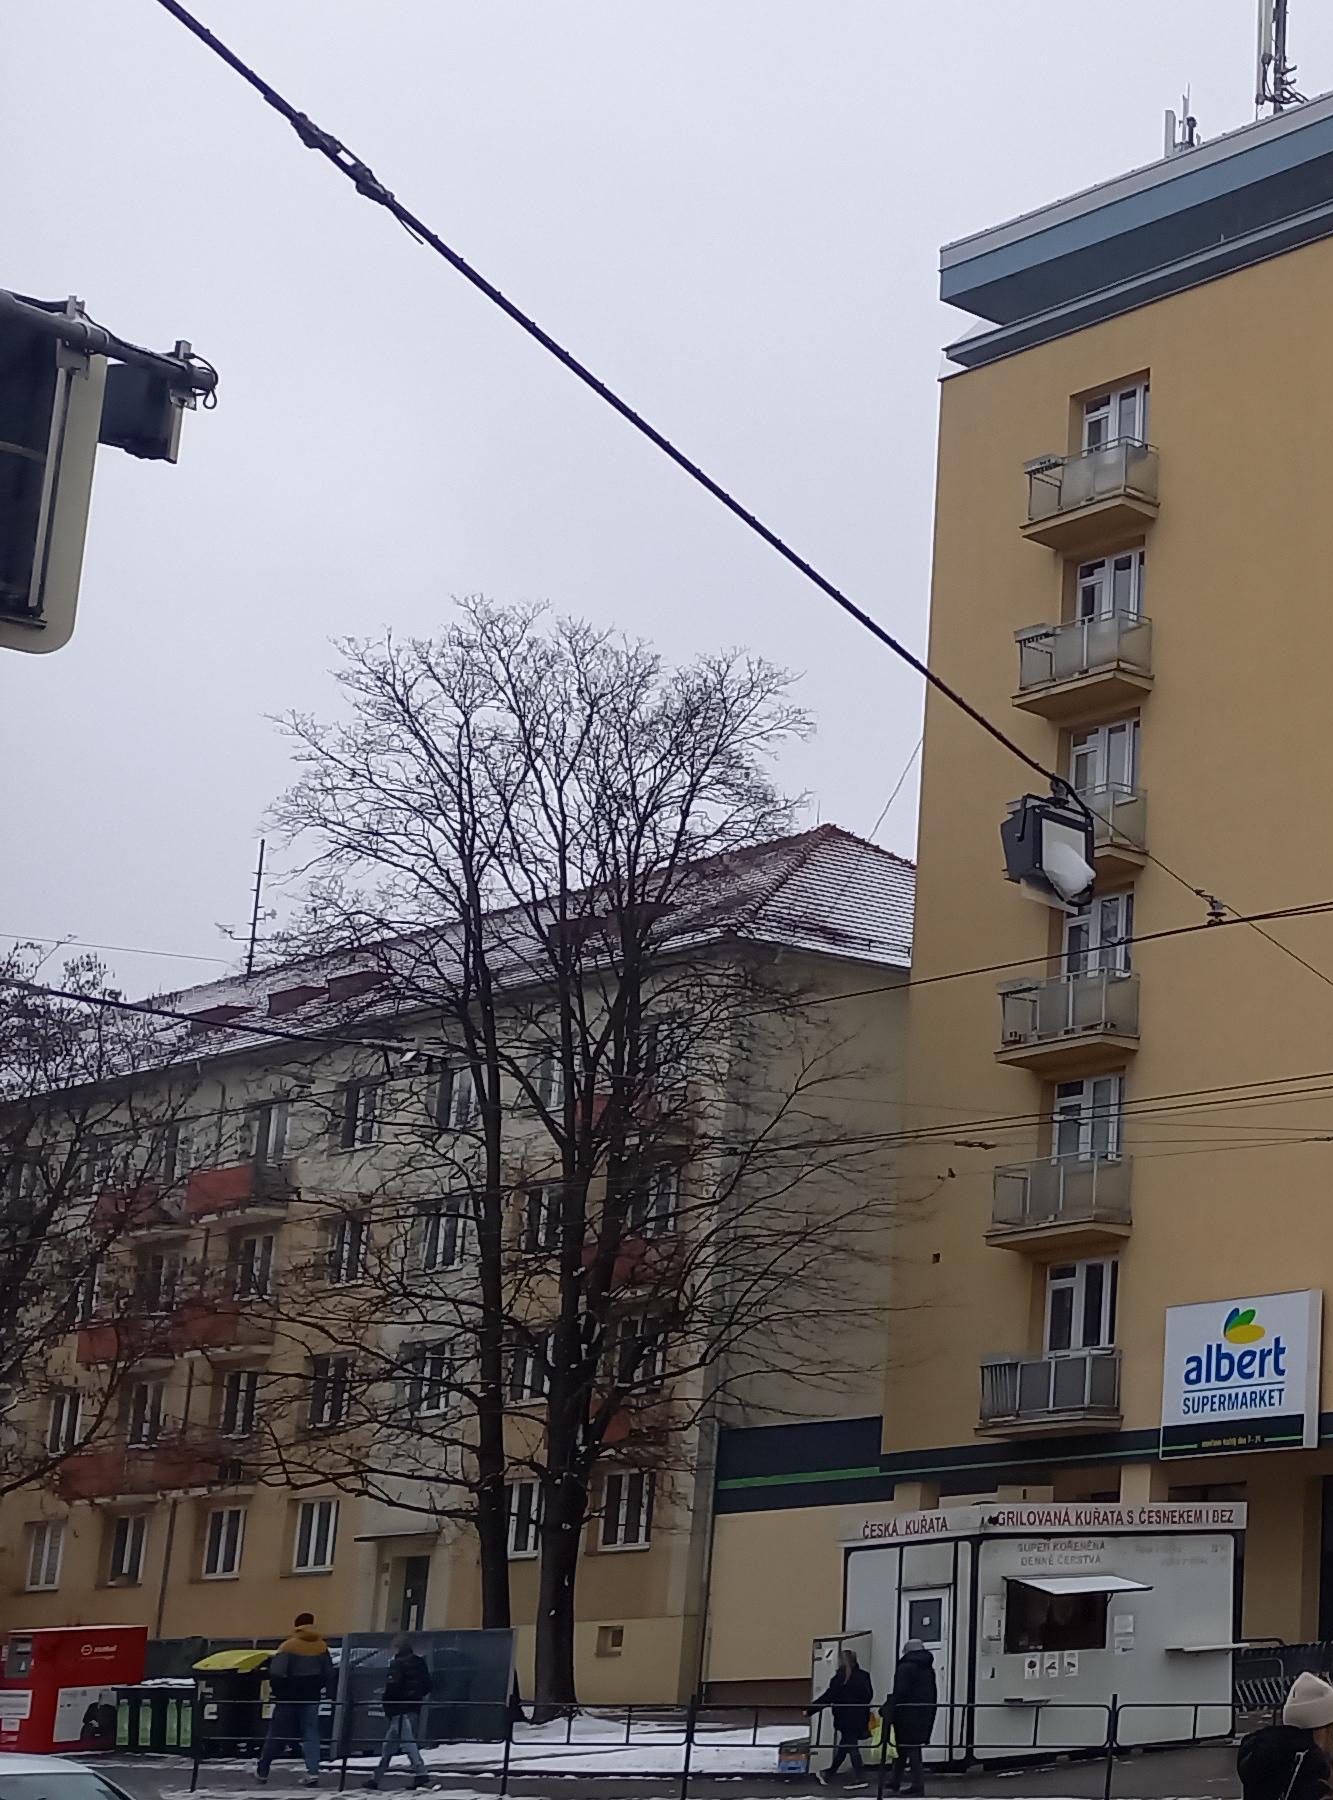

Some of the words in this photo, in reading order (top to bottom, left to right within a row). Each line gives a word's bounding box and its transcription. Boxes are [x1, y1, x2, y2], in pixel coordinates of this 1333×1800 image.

[1184, 1336, 1287, 1385] albert
[1182, 1388, 1285, 1415] SUPERMARKET
[862, 1518, 899, 1539] ČESKÁ
[905, 1515, 949, 1535] KUŘATA
[997, 1507, 1071, 1527] GRILOVANÁ
[1076, 1507, 1123, 1526] KUŘATA
[1126, 1509, 1134, 1525] S
[1139, 1506, 1201, 1525] ČESNEKEM
